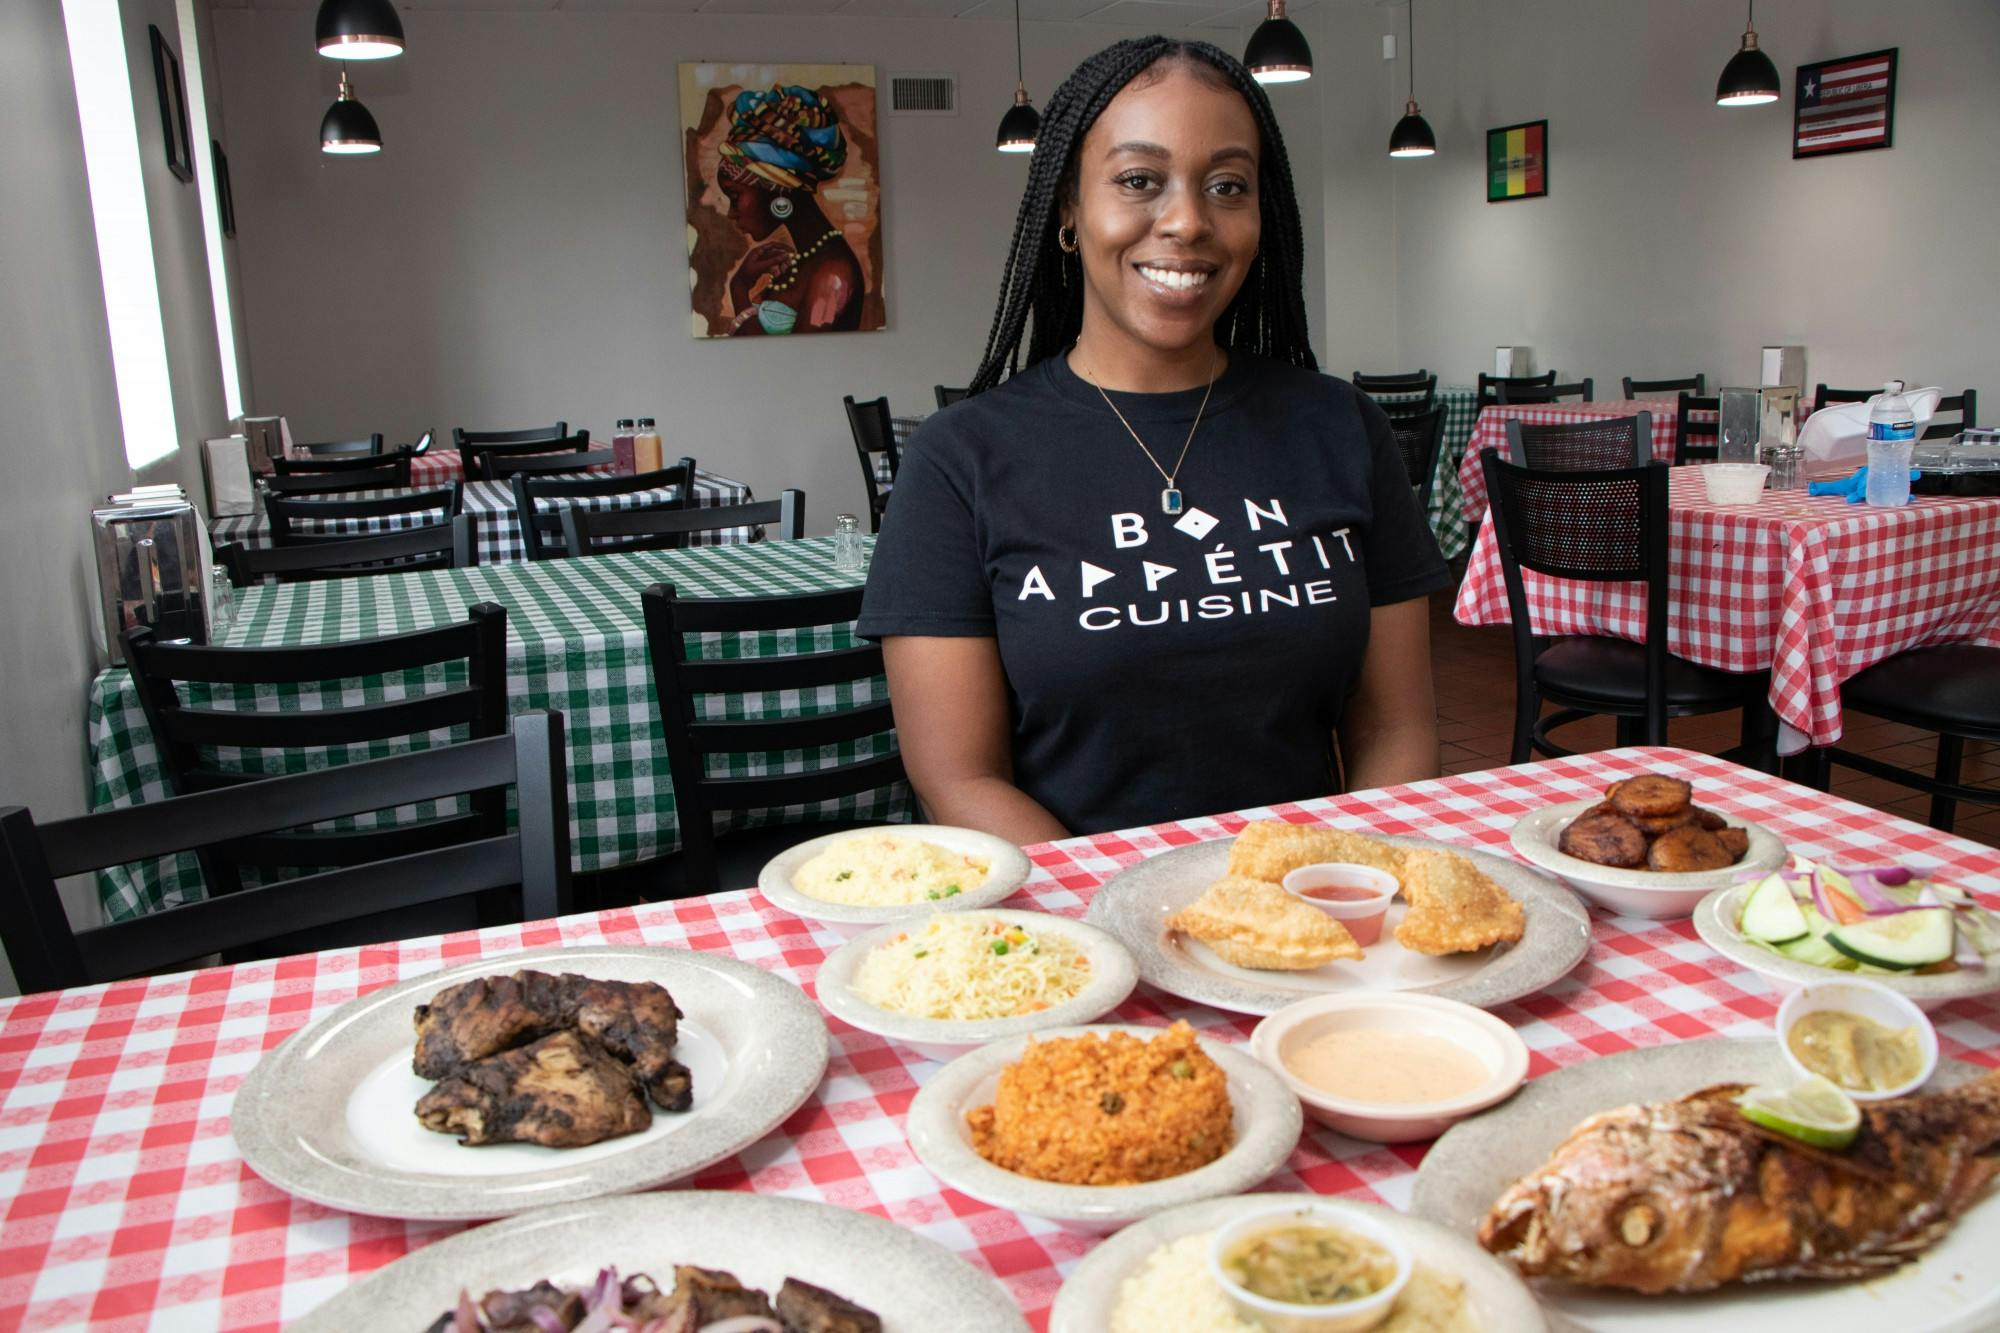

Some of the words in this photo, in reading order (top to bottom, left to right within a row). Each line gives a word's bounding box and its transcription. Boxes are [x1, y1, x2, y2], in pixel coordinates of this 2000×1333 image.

[1112, 499, 1289, 549] BON
[1018, 529, 1355, 601] APPÉTIT
[1079, 580, 1337, 631] CUISINE
